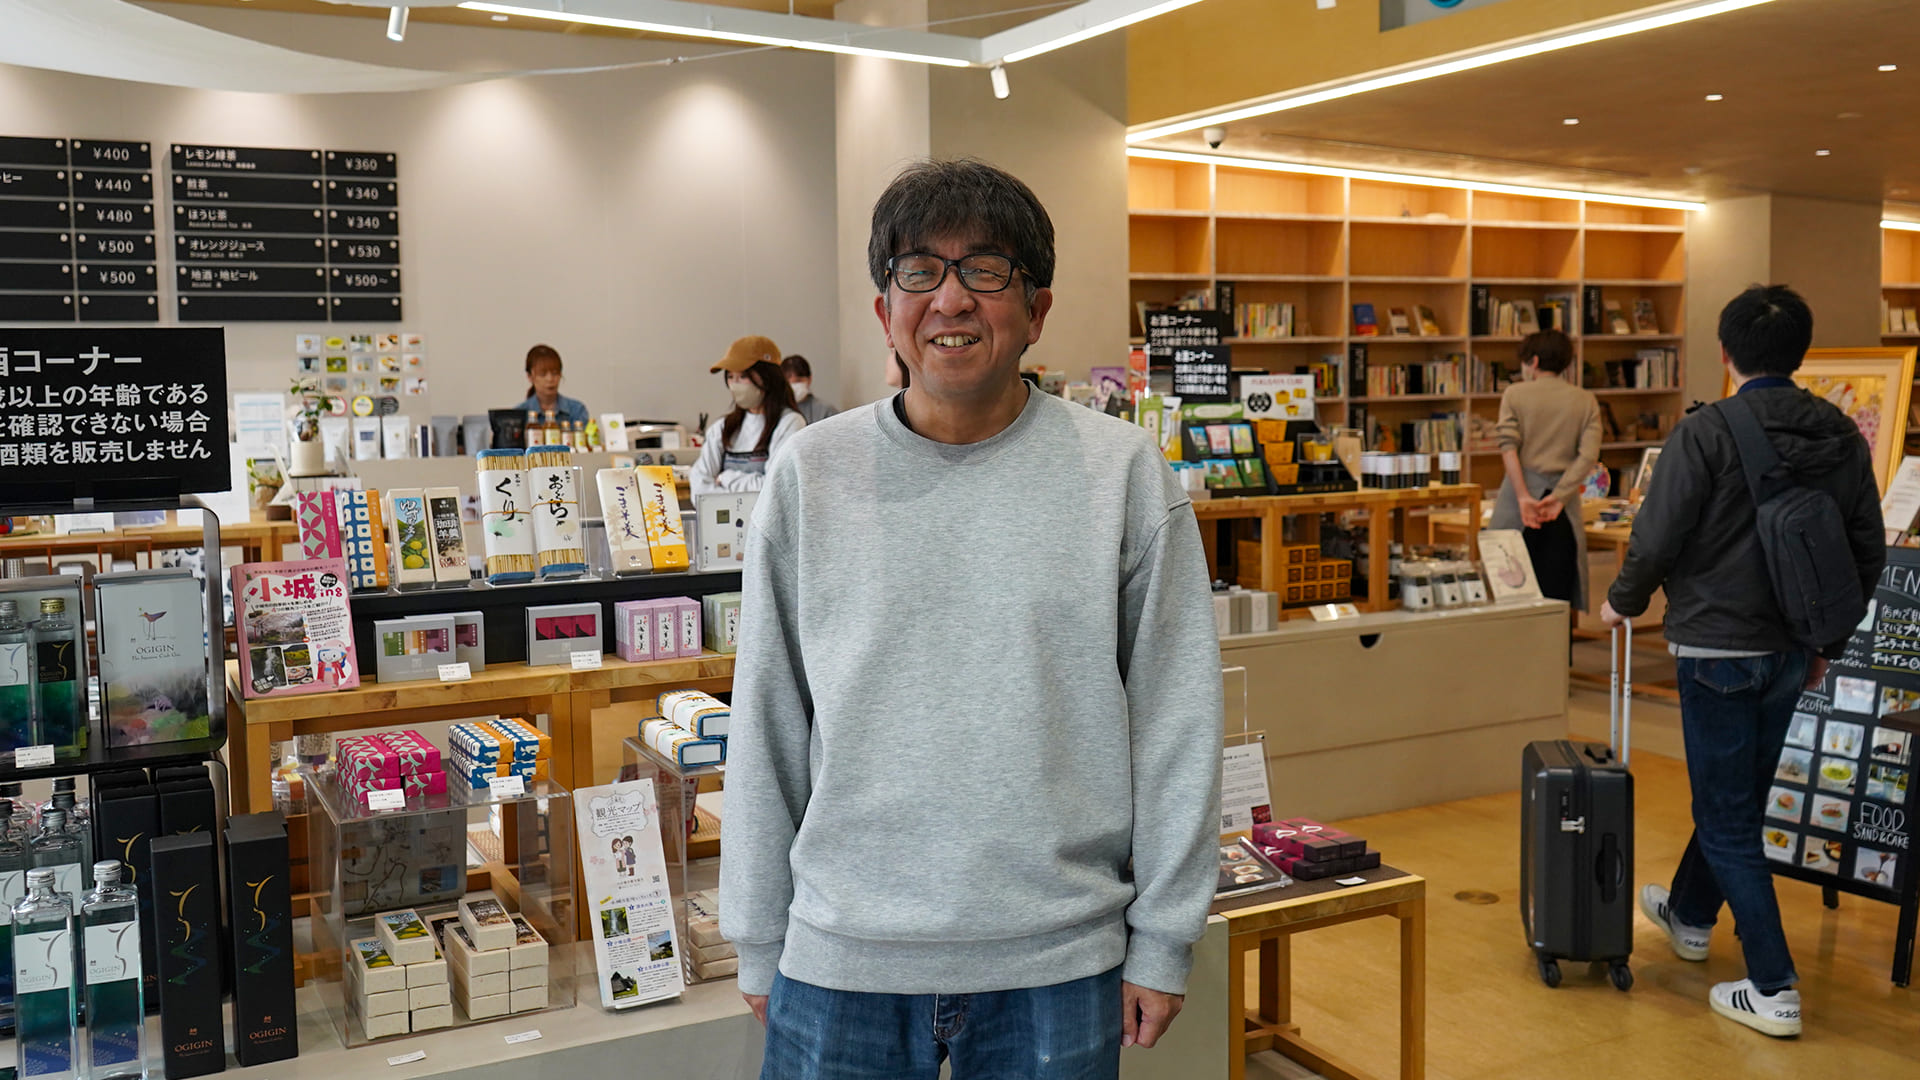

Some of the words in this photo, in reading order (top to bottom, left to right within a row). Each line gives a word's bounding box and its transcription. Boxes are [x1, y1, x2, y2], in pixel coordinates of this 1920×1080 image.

[93, 147, 130, 161] ¥400
[0, 171, 23, 184] ヒー
[94, 178, 132, 192] ¥440
[345, 186, 379, 200] ¥340
[96, 209, 133, 223] ¥480
[188, 209, 228, 221] ほうじ茶
[347, 215, 380, 229] ¥340
[98, 240, 135, 253] ¥500
[189, 240, 266, 252] オレンジジュース
[348, 245, 381, 258] ¥530
[99, 271, 136, 285] ¥500
[0, 382, 209, 409] 以上の年齢である
[495, 477, 516, 522] くり
[136, 644, 175, 655] OGIGIN
[595, 802, 641, 818] 観光マップ
[1860, 801, 1905, 832] FOOD
[248, 1026, 288, 1041] OGIGIN
[174, 1039, 214, 1053] OGIGIN
